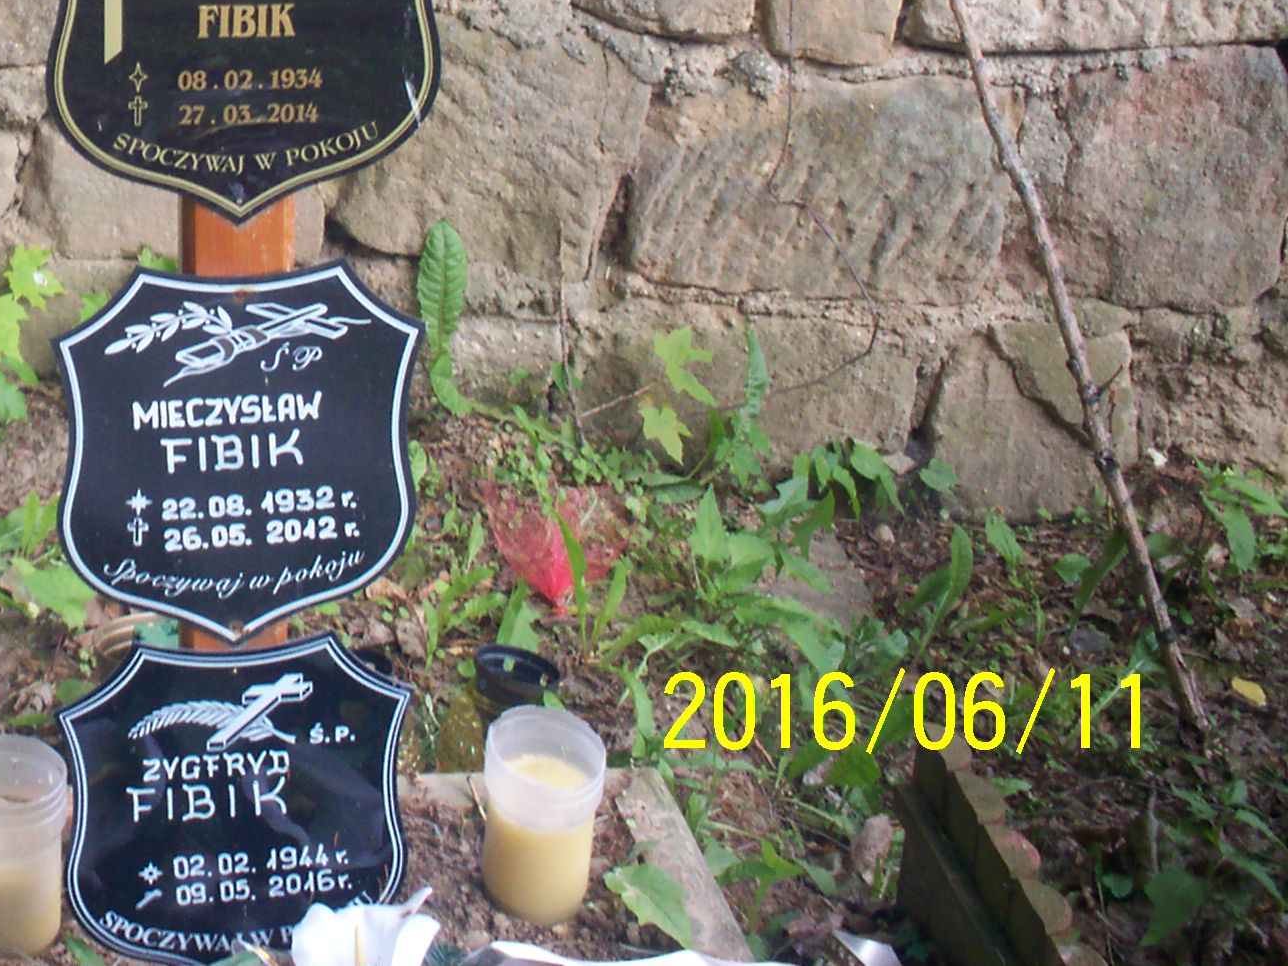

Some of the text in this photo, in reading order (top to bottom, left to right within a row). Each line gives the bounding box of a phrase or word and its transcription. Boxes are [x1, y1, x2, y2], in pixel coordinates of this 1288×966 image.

[198, 2, 296, 39] FIBIK
[112, 121, 379, 176] SPOCZYWAJ W POKOJU
[132, 390, 323, 431] MIECZYSŁAW
[160, 428, 304, 474] FIBIK
[103, 558, 244, 600] Spoczywaj
[272, 548, 364, 595] pokoju
[142, 749, 291, 783] ZYGFRYD
[125, 775, 288, 823] FIBIK
[99, 910, 243, 951] SPOCZYWA
